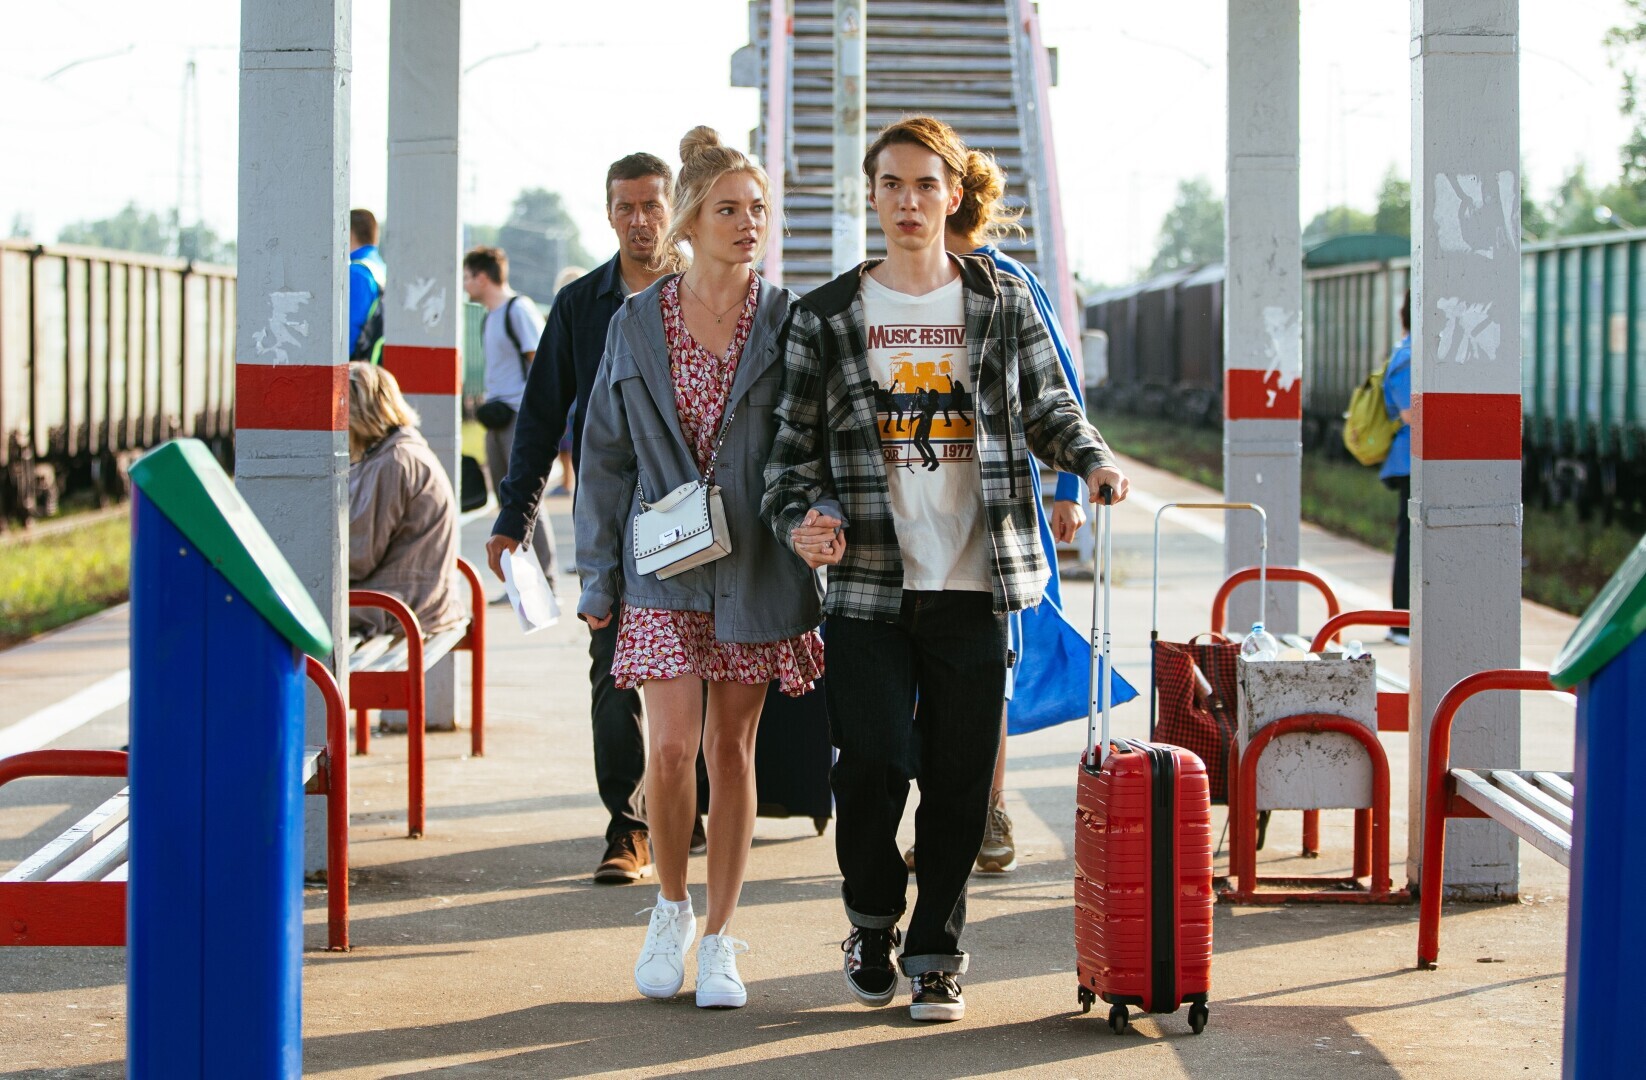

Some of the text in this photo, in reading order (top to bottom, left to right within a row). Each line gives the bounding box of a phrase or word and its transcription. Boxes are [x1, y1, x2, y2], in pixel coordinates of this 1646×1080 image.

[867, 325, 917, 349] MUSIC
[882, 444, 973, 460] OUR 1977
